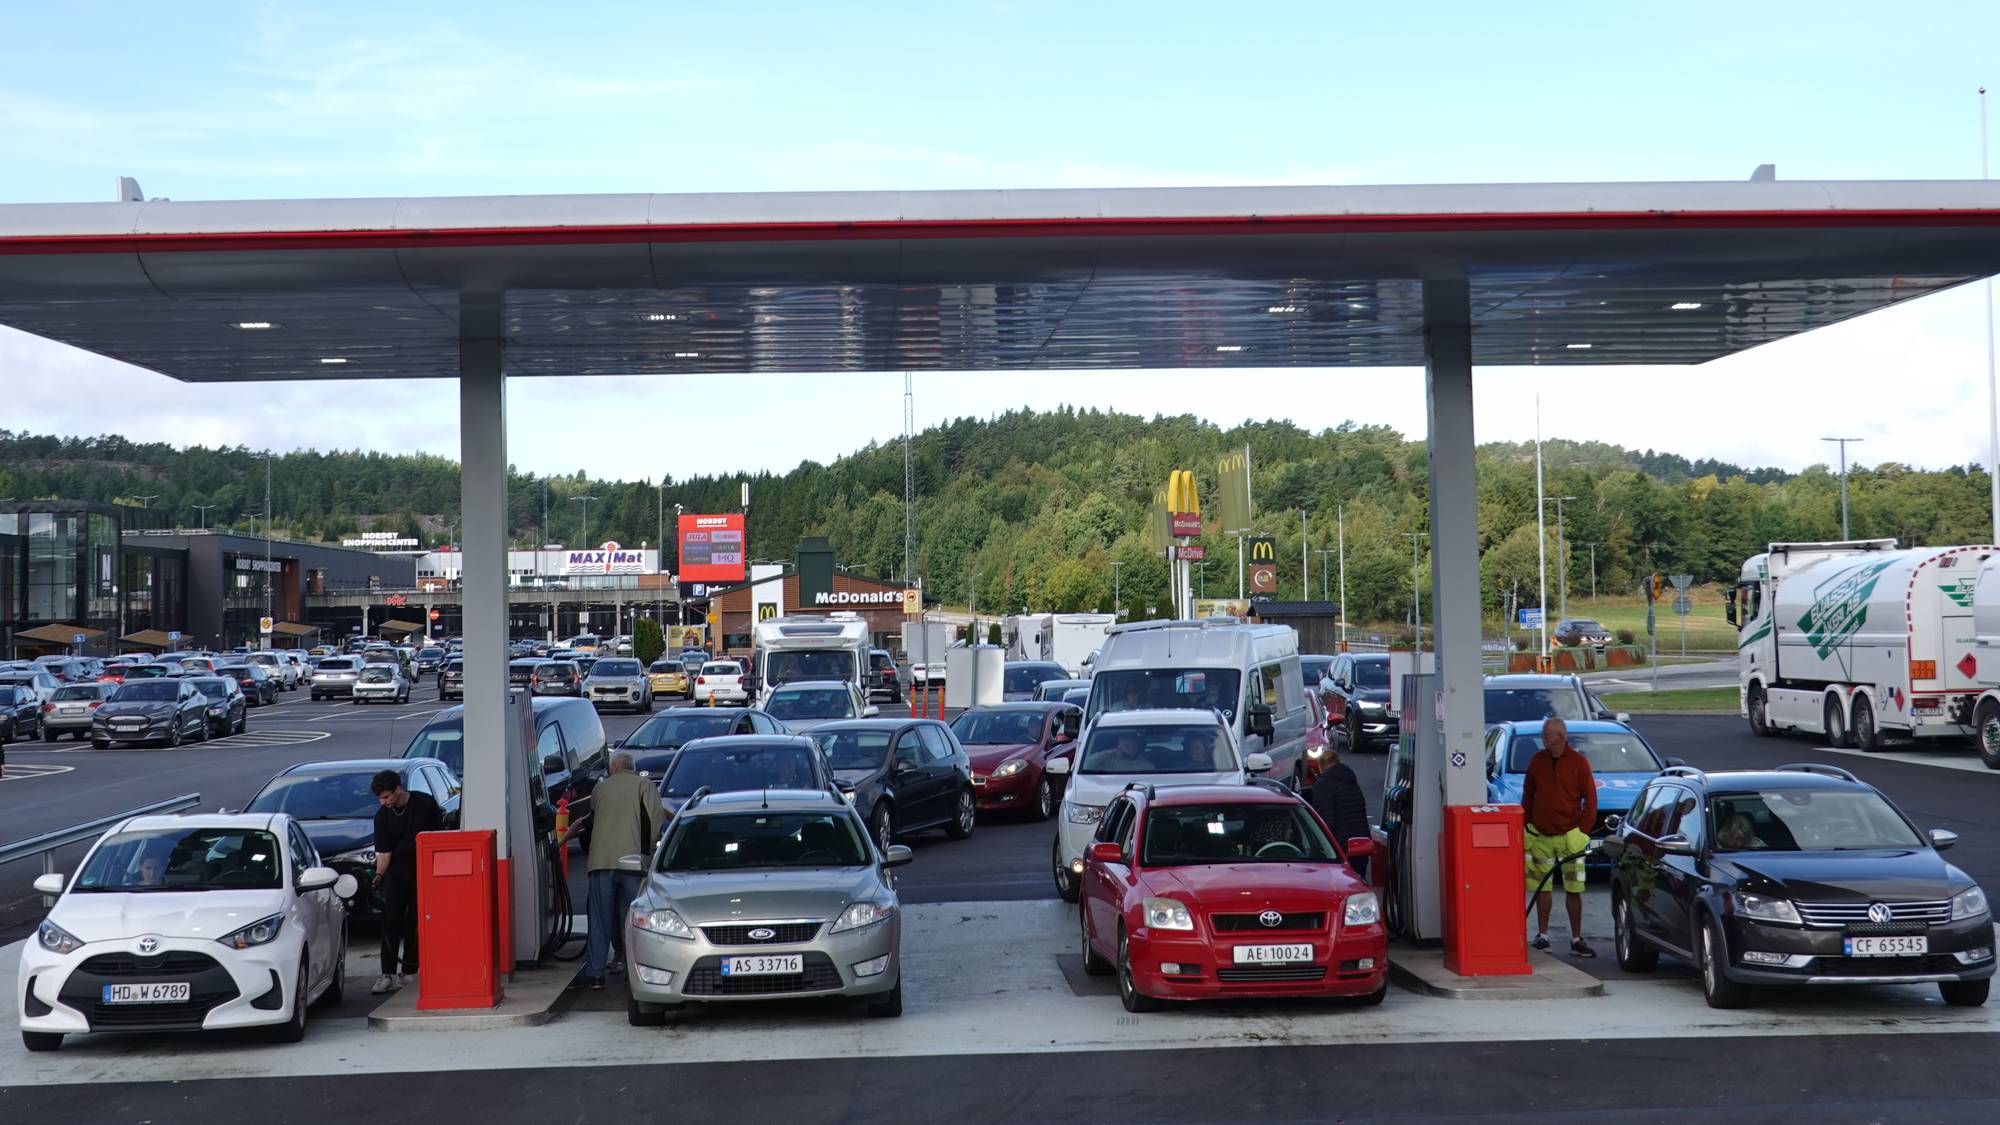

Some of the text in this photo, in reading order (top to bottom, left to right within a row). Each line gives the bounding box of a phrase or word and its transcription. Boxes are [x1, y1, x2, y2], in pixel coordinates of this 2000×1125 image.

[696, 517, 727, 525] NORDBY
[342, 539, 418, 547] SHOPPINGCENTER
[1178, 547, 1203, 559] McDrive
[815, 591, 904, 604] McDonald's
[1856, 938, 1923, 952] CF 65545
[1247, 946, 1309, 960] AE 10024
[735, 959, 752, 972] AS
[758, 958, 798, 972] 33716
[112, 984, 188, 1000] HD W 6789
